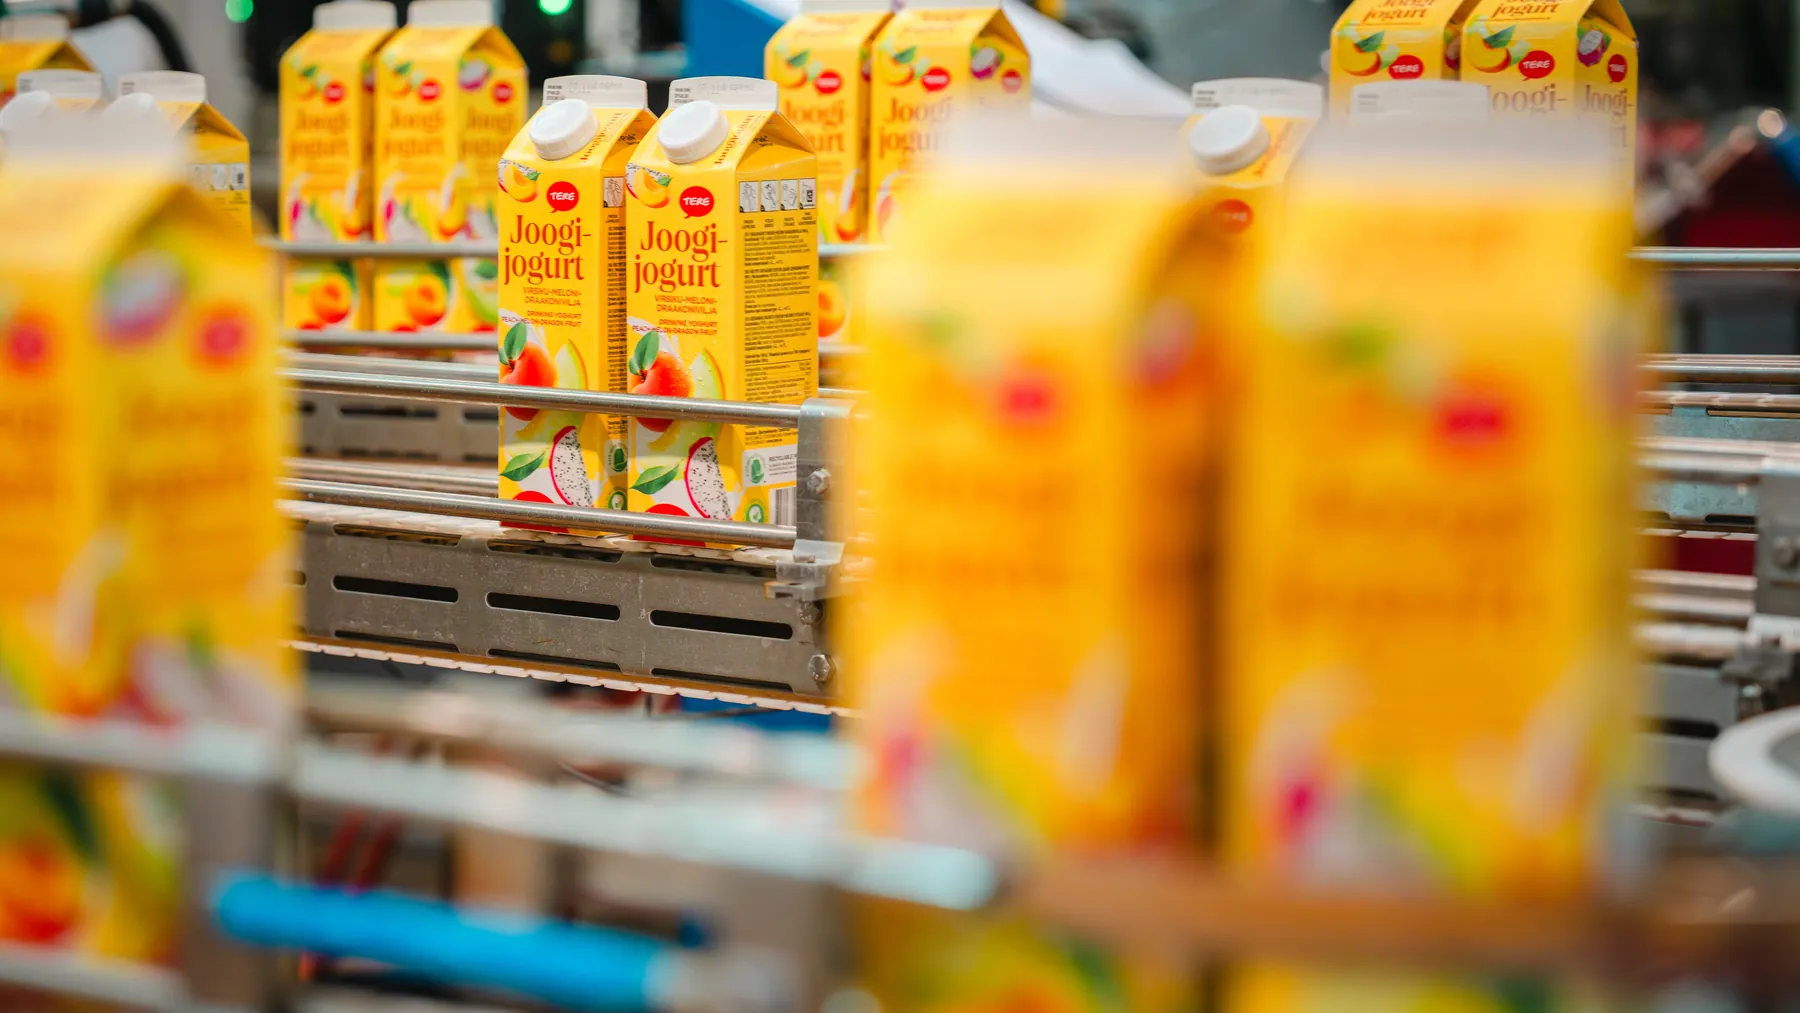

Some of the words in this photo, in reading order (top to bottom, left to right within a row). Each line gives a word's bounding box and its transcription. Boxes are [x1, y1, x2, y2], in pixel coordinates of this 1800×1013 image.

[1522, 59, 1550, 70] TERE
[550, 191, 576, 201] TERE
[682, 197, 710, 207] TERE
[510, 214, 592, 256] Joogi-
[640, 220, 728, 263] Joogi-
[503, 247, 585, 285] jogurt
[634, 254, 721, 294] jogurt
[523, 286, 582, 297] VIRSIKU-MELONI-
[525, 295, 581, 306] DRAAKONIVILJA
[655, 294, 717, 305] VIRSIKU-MELONI-
[656, 304, 717, 315] DRAAKONIVILJA
